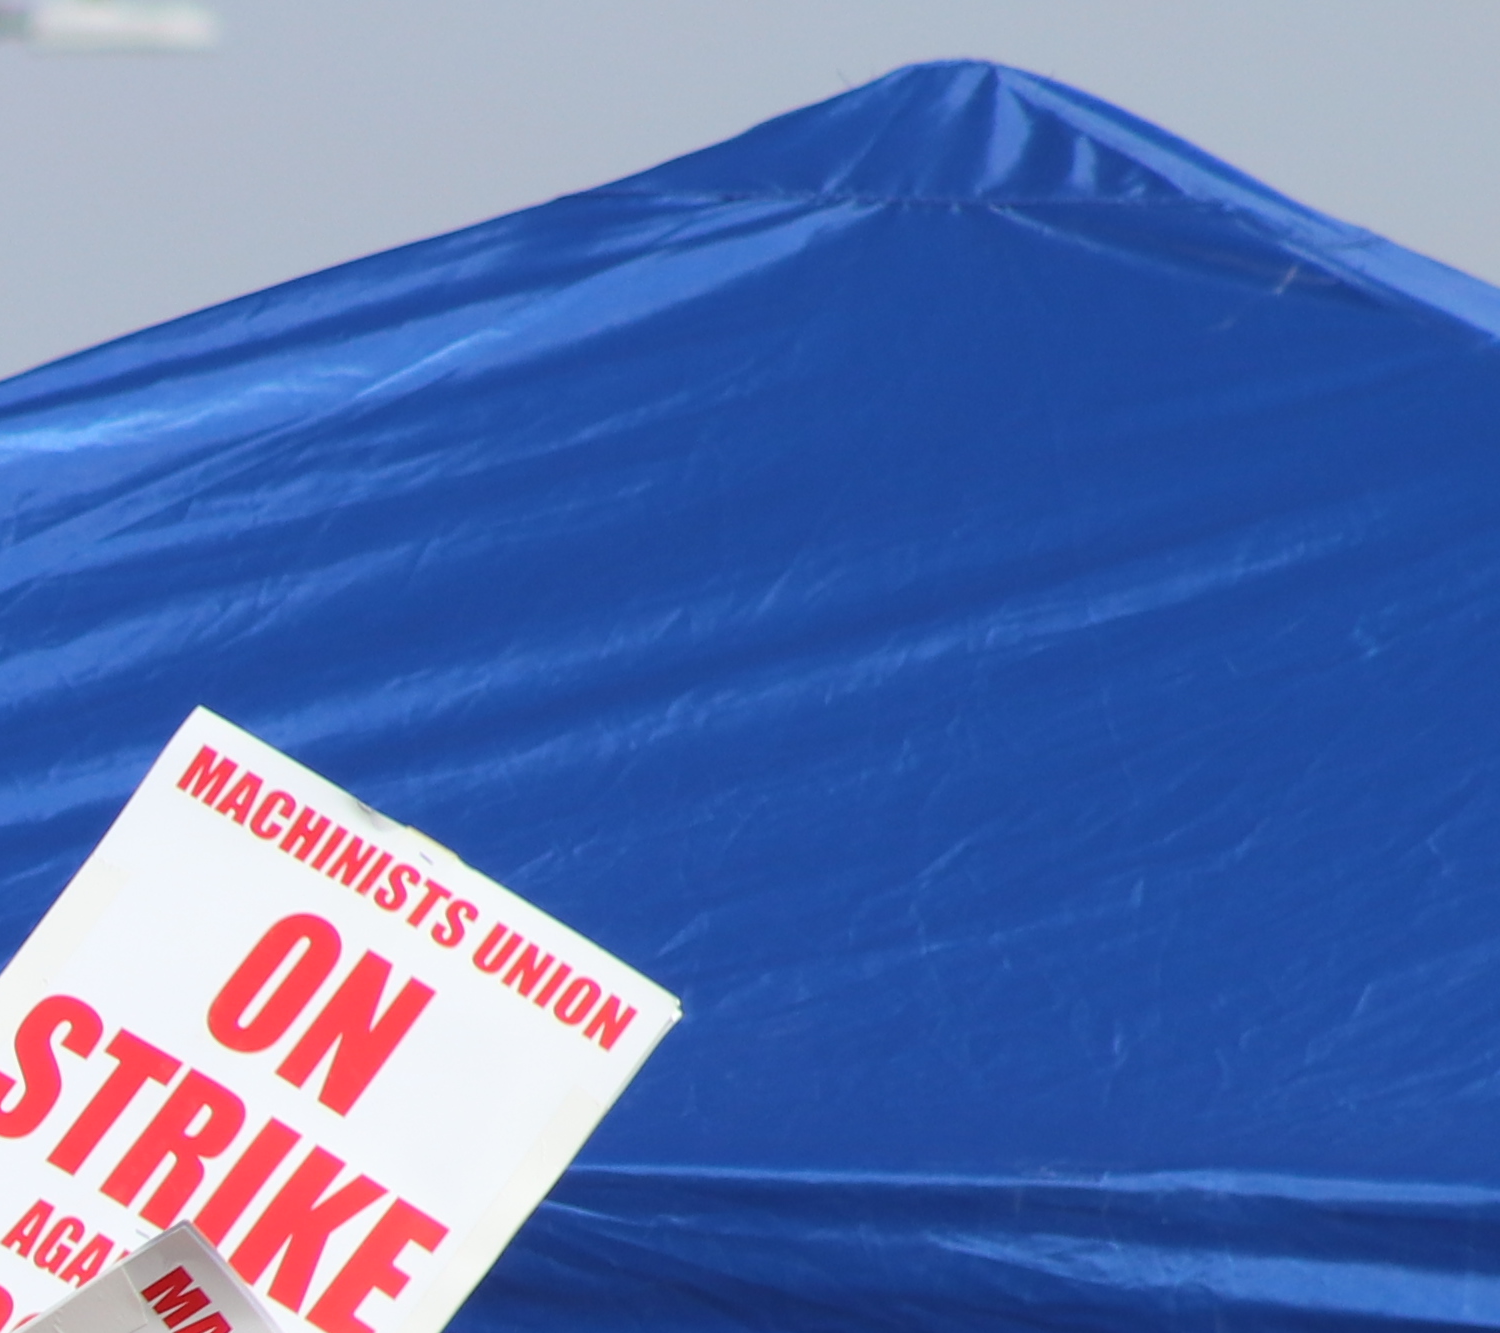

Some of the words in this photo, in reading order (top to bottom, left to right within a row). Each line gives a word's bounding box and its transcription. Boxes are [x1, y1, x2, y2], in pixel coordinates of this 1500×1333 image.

[178, 746, 478, 948] MACHINISTS
[473, 924, 637, 1050] UNION
[208, 913, 435, 1116] ON
